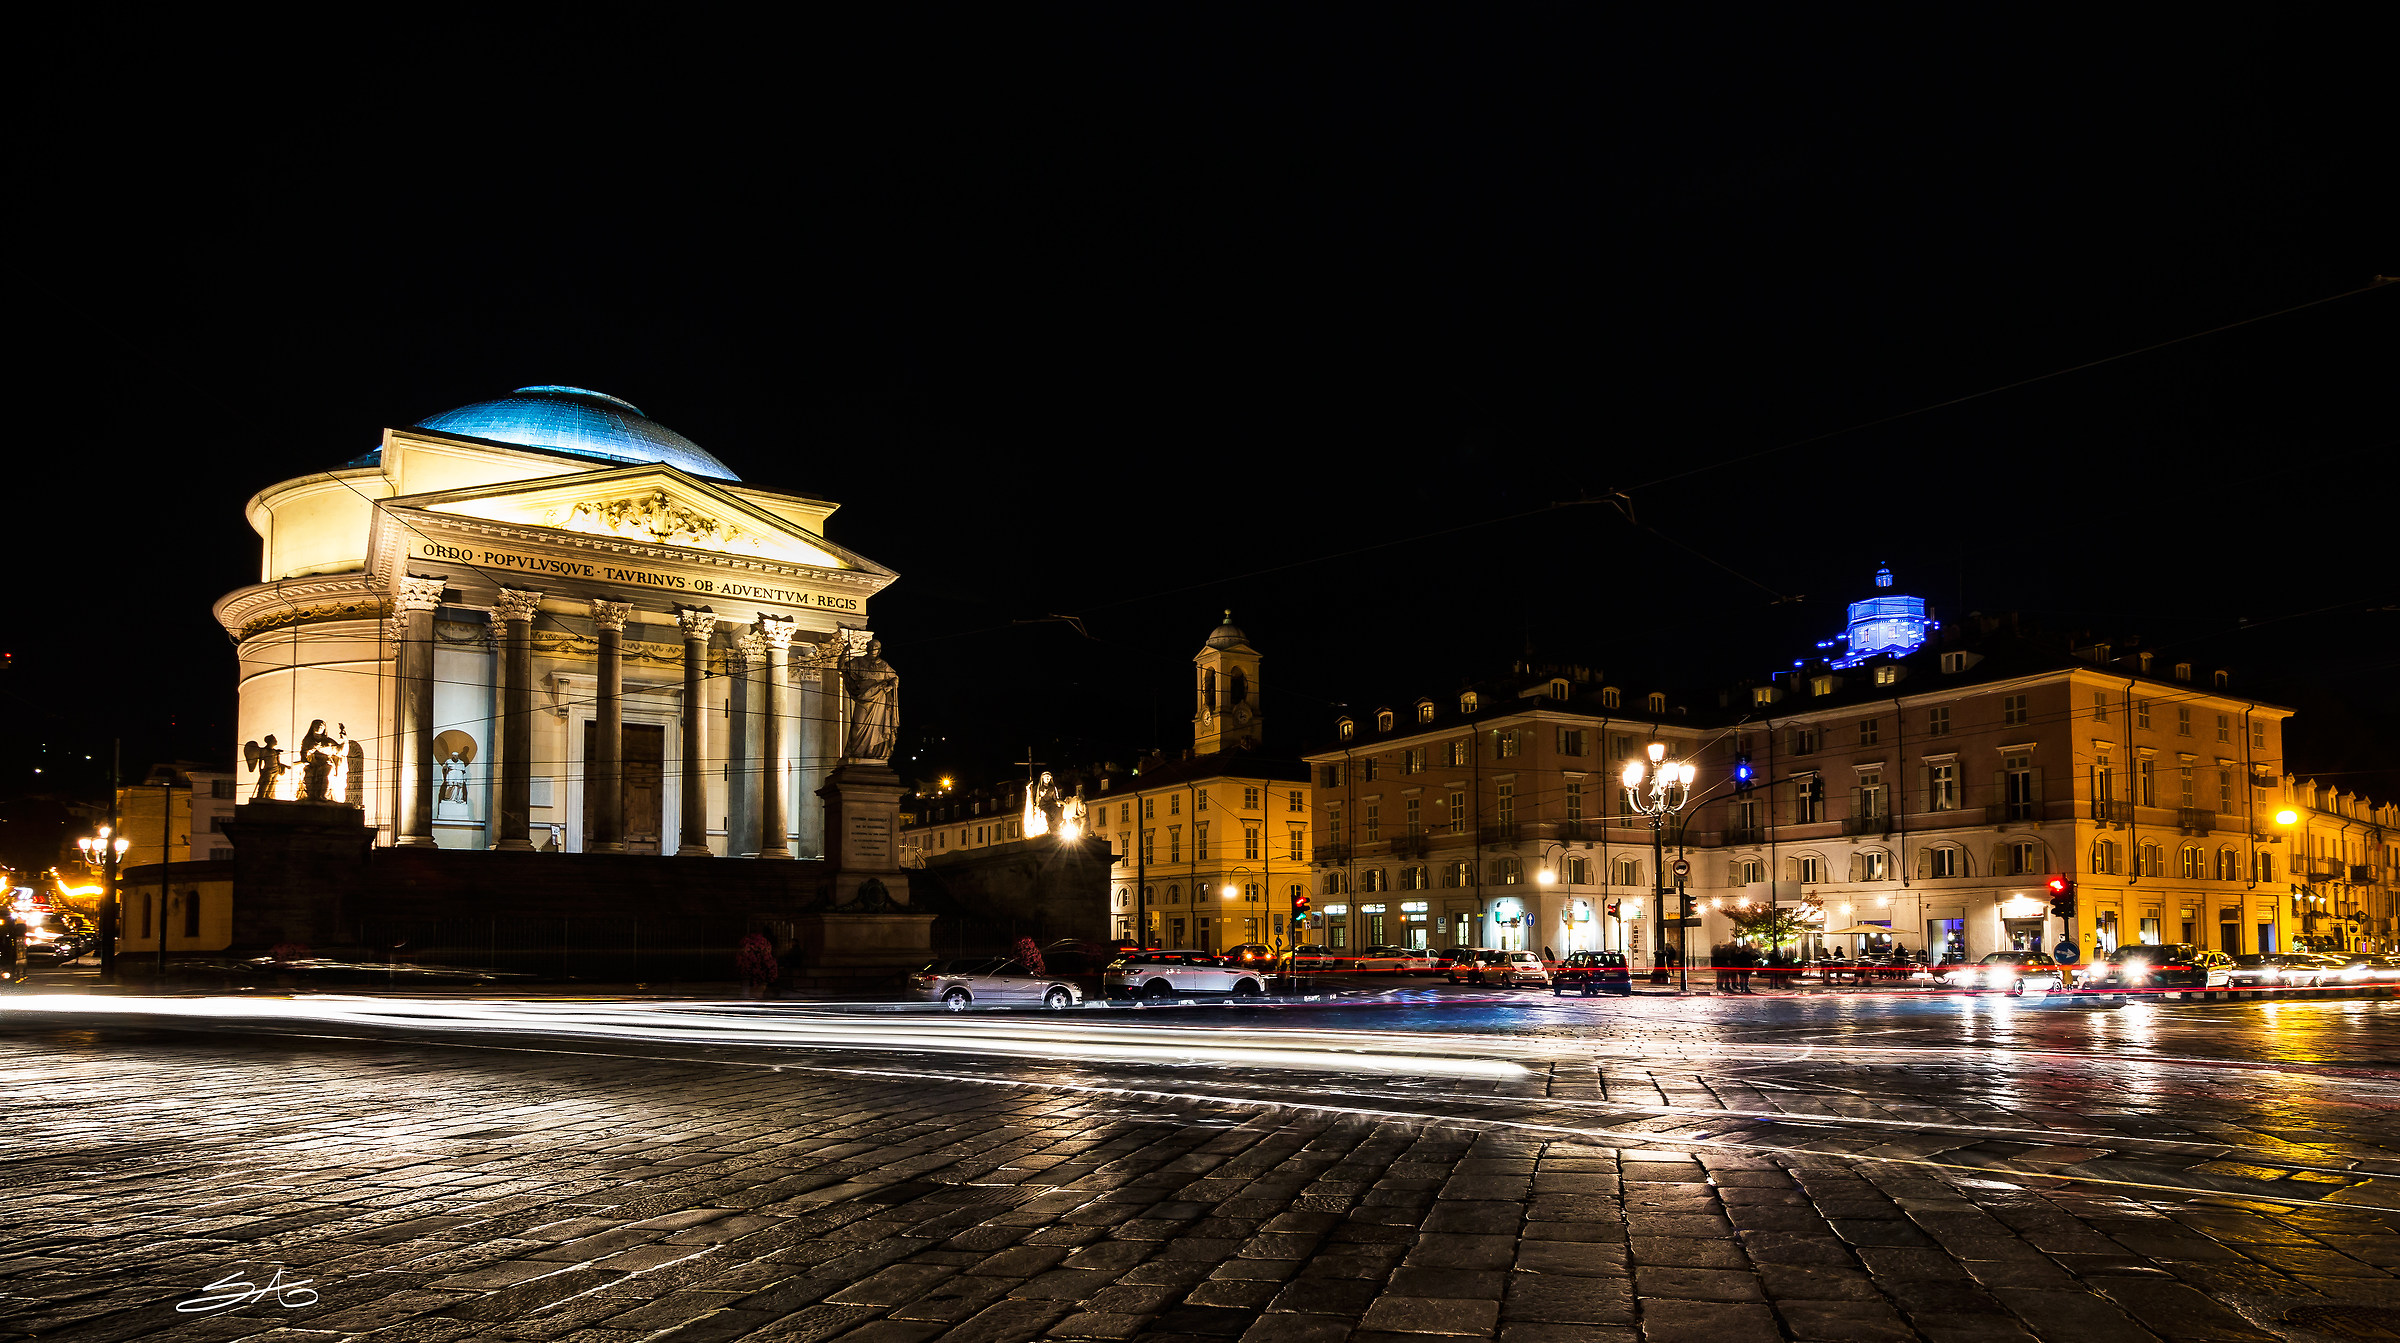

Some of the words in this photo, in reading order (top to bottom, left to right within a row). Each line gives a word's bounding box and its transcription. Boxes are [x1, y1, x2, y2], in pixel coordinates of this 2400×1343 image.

[423, 544, 473, 561] ORDO
[484, 552, 594, 577] POPVLVSQVE
[603, 567, 685, 588] TAVRINVS
[694, 579, 713, 592] OB
[721, 583, 808, 604] ADVENTVM
[817, 596, 857, 610] REGIS
